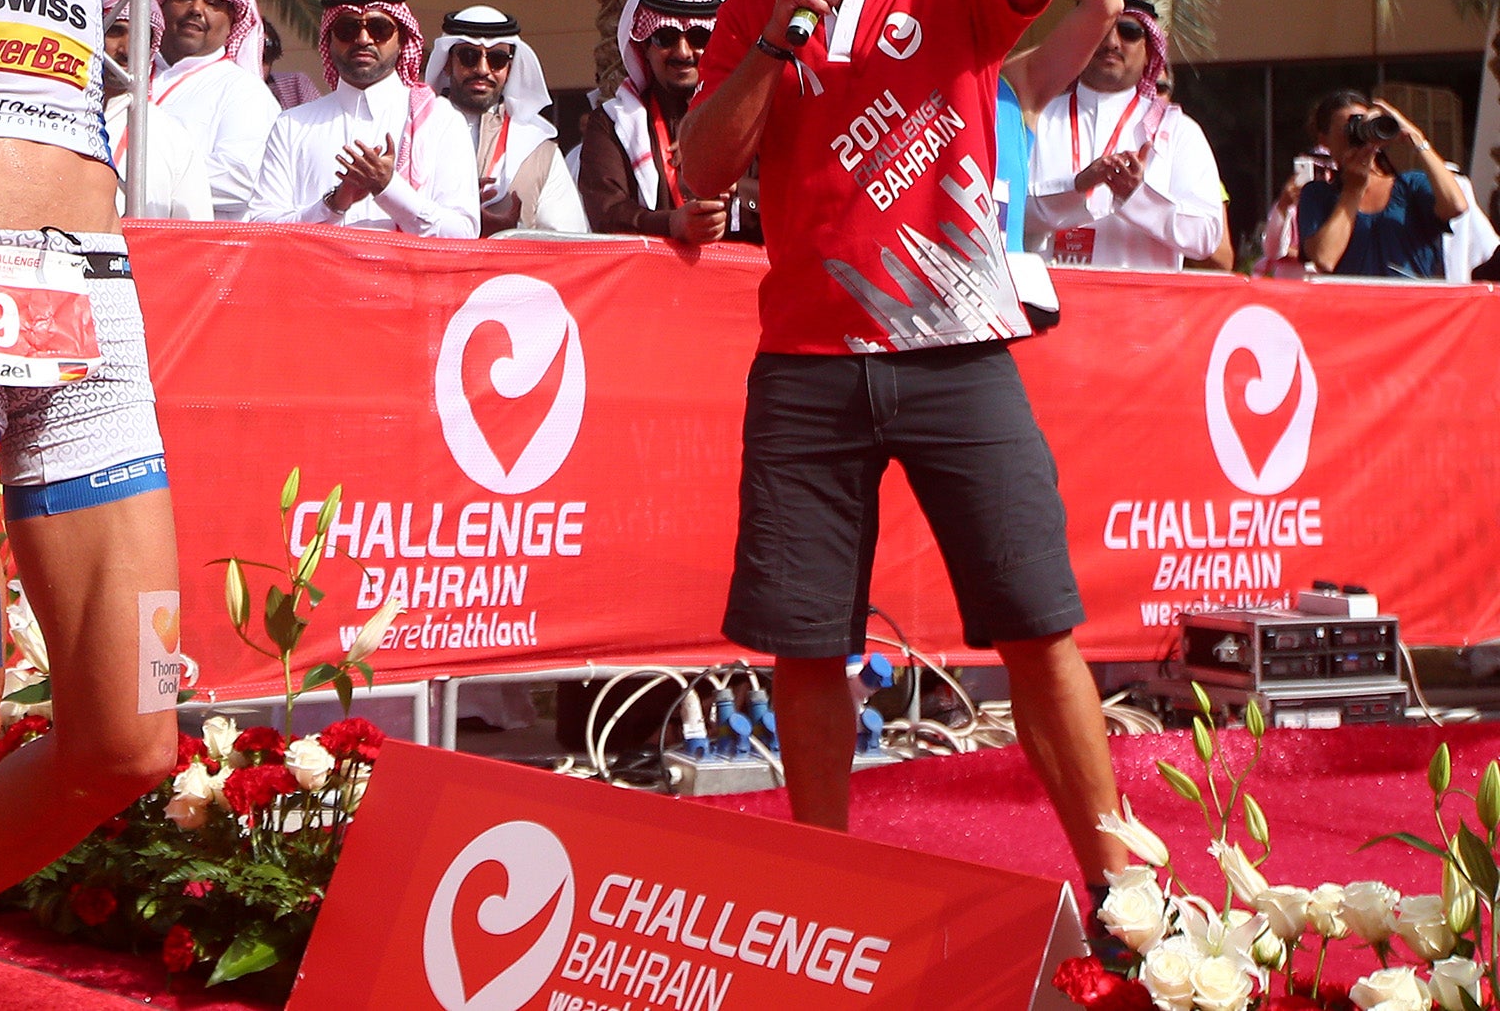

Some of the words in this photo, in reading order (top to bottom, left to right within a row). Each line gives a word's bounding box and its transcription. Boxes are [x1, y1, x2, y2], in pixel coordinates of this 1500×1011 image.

[830, 89, 907, 172] 2014
[852, 88, 948, 188] CHALLENGE
[866, 105, 966, 213] BAHRAIN
[290, 501, 587, 559] CHALLENGE
[1103, 498, 1324, 550] CHALLENGE
[356, 564, 528, 610] BAHRAIN
[1152, 553, 1282, 591] BAHRAIN
[339, 611, 538, 653] waretriathlon!
[150, 661, 180, 678] Thoma
[589, 874, 891, 994] CHALLENGE
[561, 933, 733, 1011] BAHRAIN
